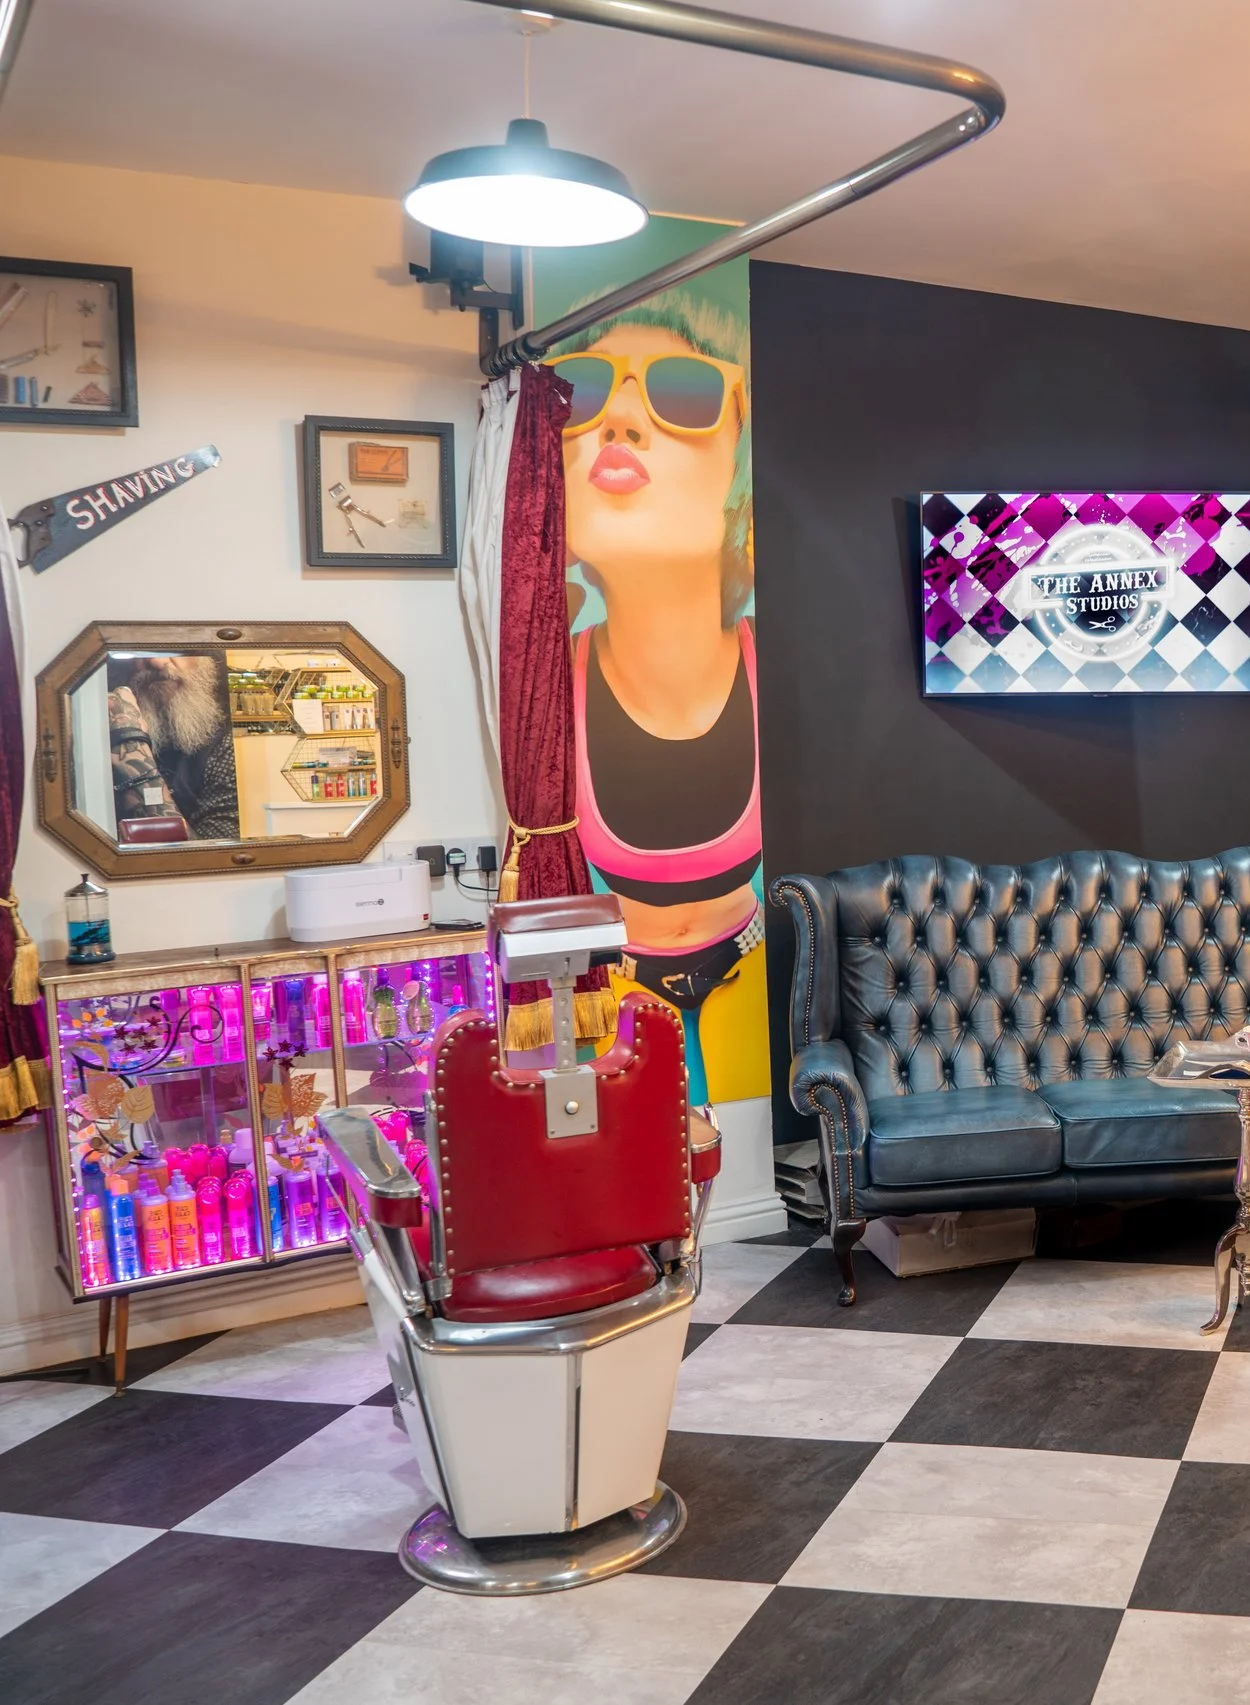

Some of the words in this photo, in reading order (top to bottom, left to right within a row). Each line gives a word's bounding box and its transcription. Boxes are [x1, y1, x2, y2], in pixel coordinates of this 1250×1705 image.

[1037, 576, 1081, 597] THE
[1089, 570, 1159, 593] ANNEX
[1066, 594, 1139, 615] STUDIOS
